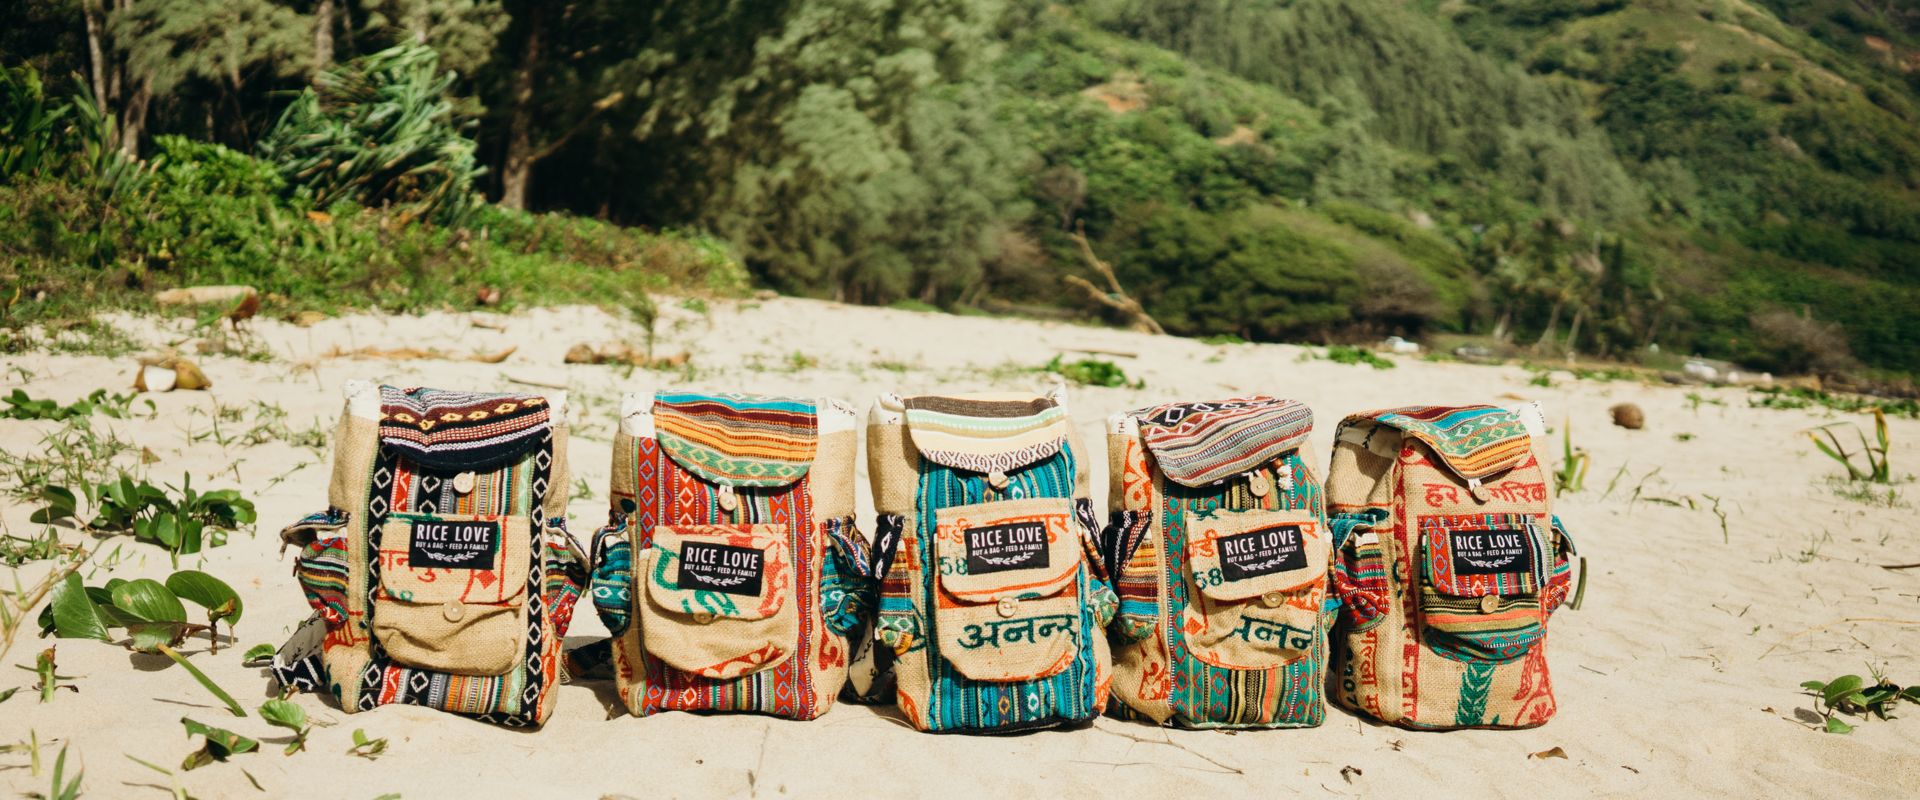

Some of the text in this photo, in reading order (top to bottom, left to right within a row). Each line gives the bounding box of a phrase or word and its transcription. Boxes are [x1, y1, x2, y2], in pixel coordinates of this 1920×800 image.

[416, 524, 491, 543] RICE LOVE
[971, 530, 1002, 548] RICE
[1008, 526, 1042, 544] LOVE
[1224, 537, 1256, 556] RICE
[1262, 530, 1296, 549] LOVE
[1456, 534, 1522, 550] RICE LOVE
[1024, 543, 1043, 551] FAMILY
[1227, 556, 1238, 564] BUY
[1243, 553, 1254, 561] BAG
[1259, 550, 1272, 558] FEED
[1278, 545, 1297, 554] FAMILY
[686, 547, 759, 569] RICE LOVE
[939, 556, 968, 576] 58
